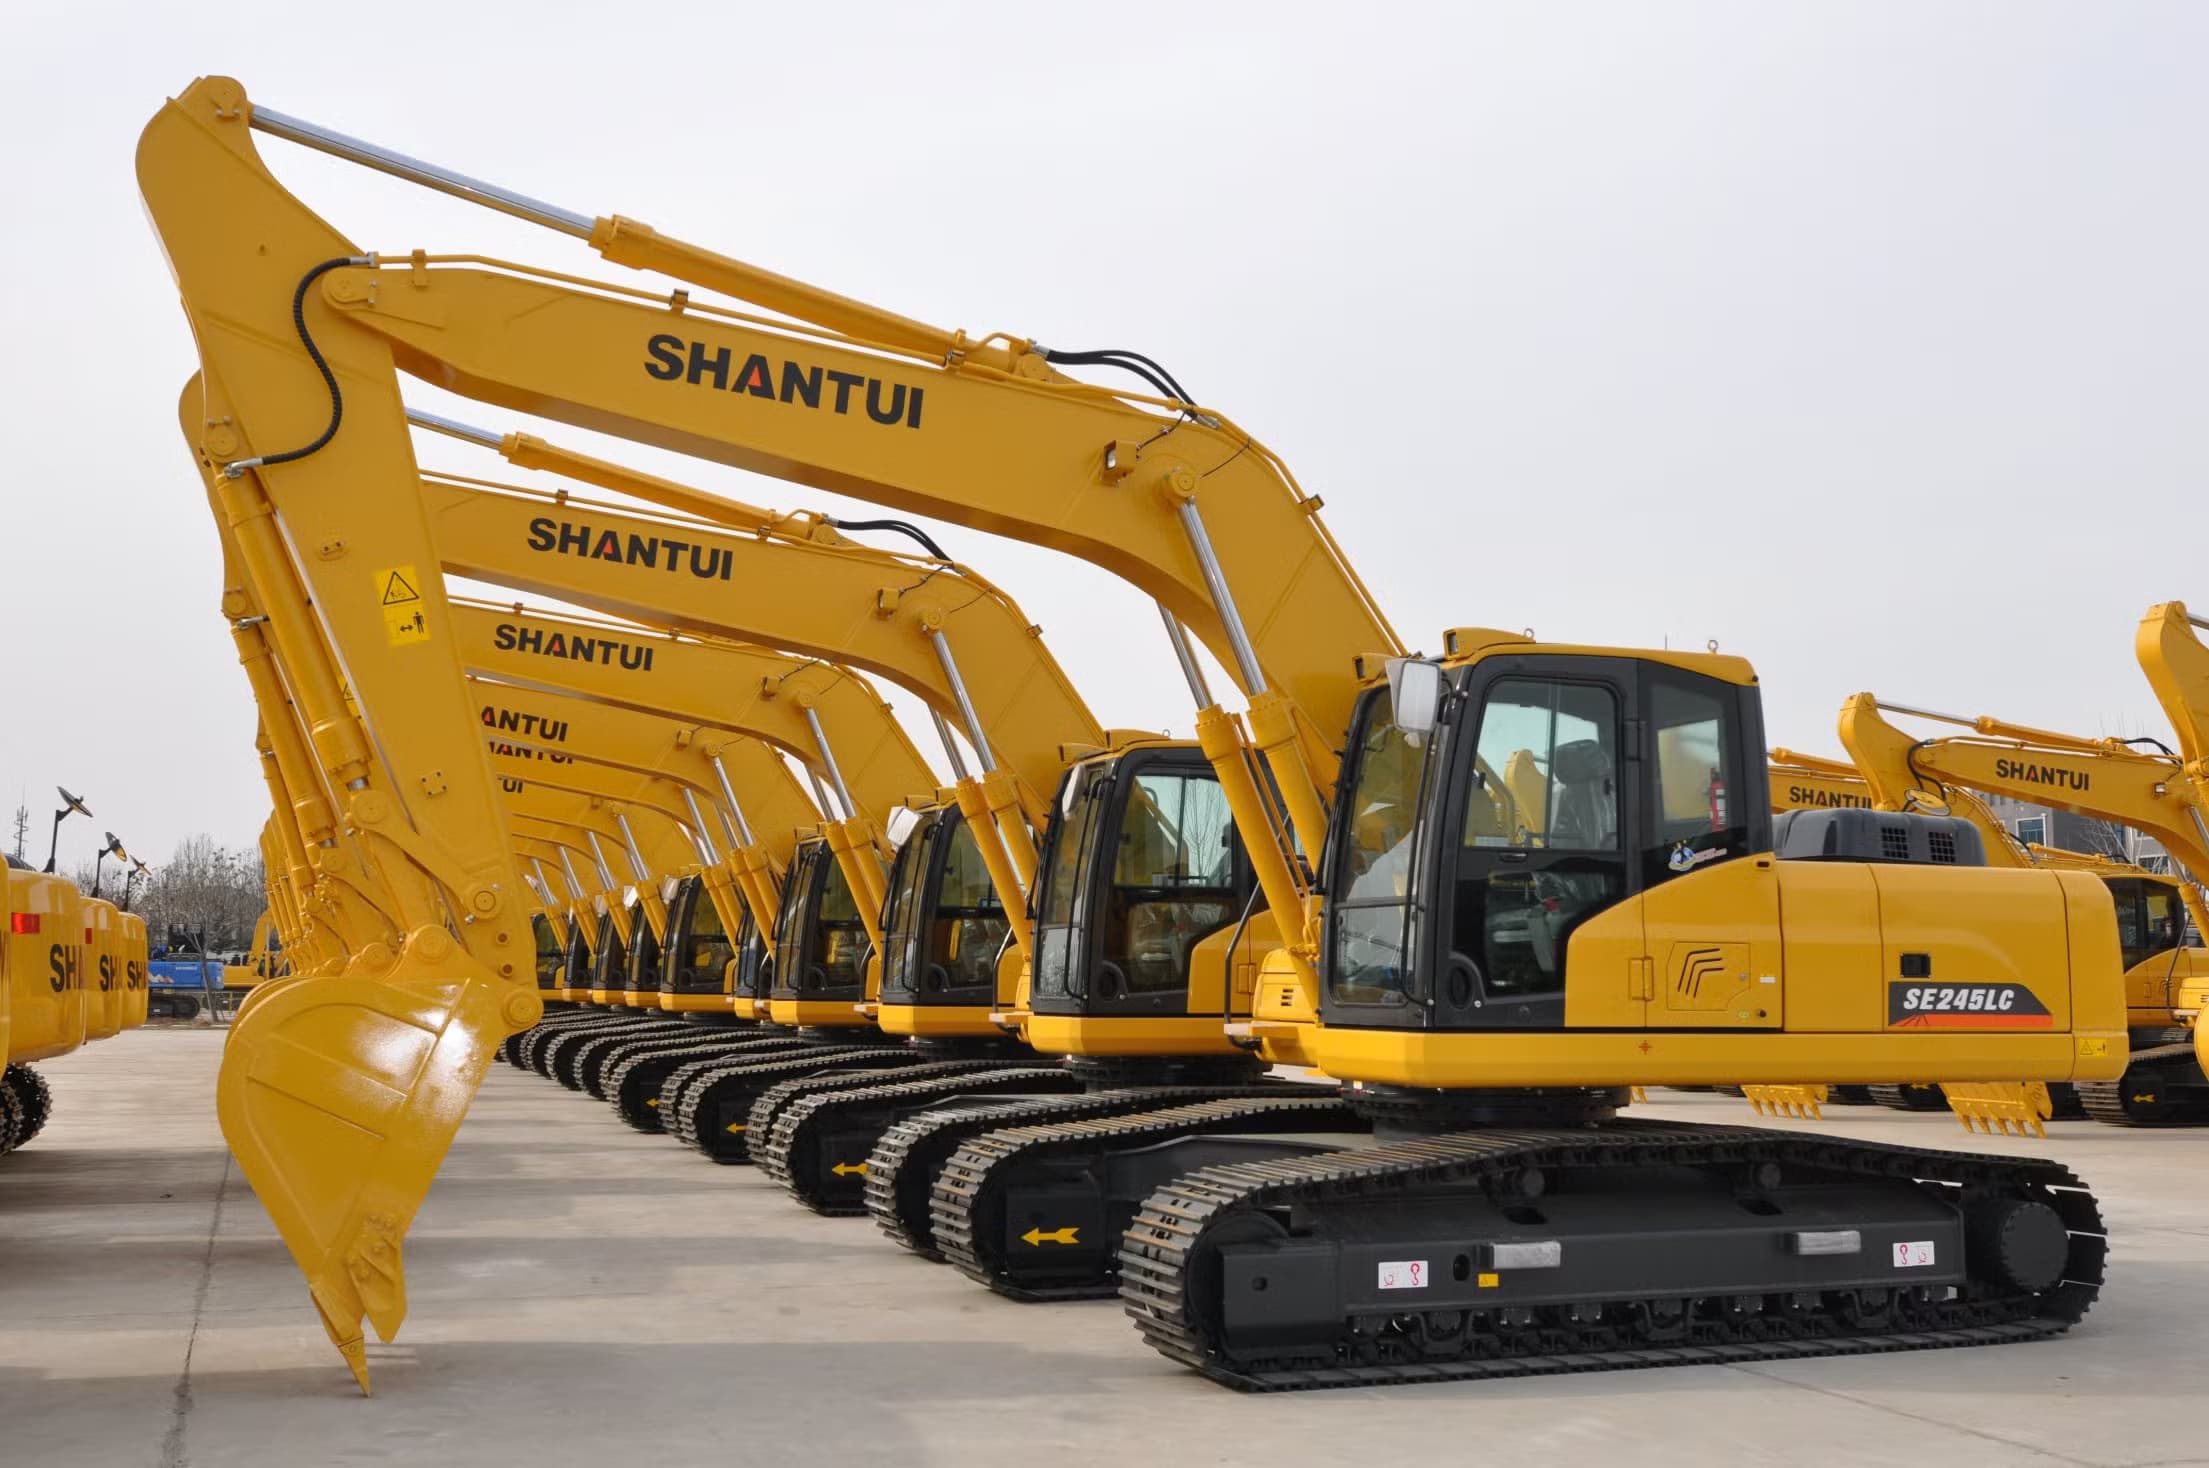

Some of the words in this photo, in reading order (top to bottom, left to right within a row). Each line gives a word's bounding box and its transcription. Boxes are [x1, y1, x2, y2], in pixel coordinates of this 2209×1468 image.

[644, 334, 924, 429] SHANTUI
[527, 517, 733, 581] SHANTUI
[494, 624, 654, 671] SHANTUI
[1996, 759, 2089, 791] SHANTUI
[1903, 988, 2015, 1011] SE245LC
